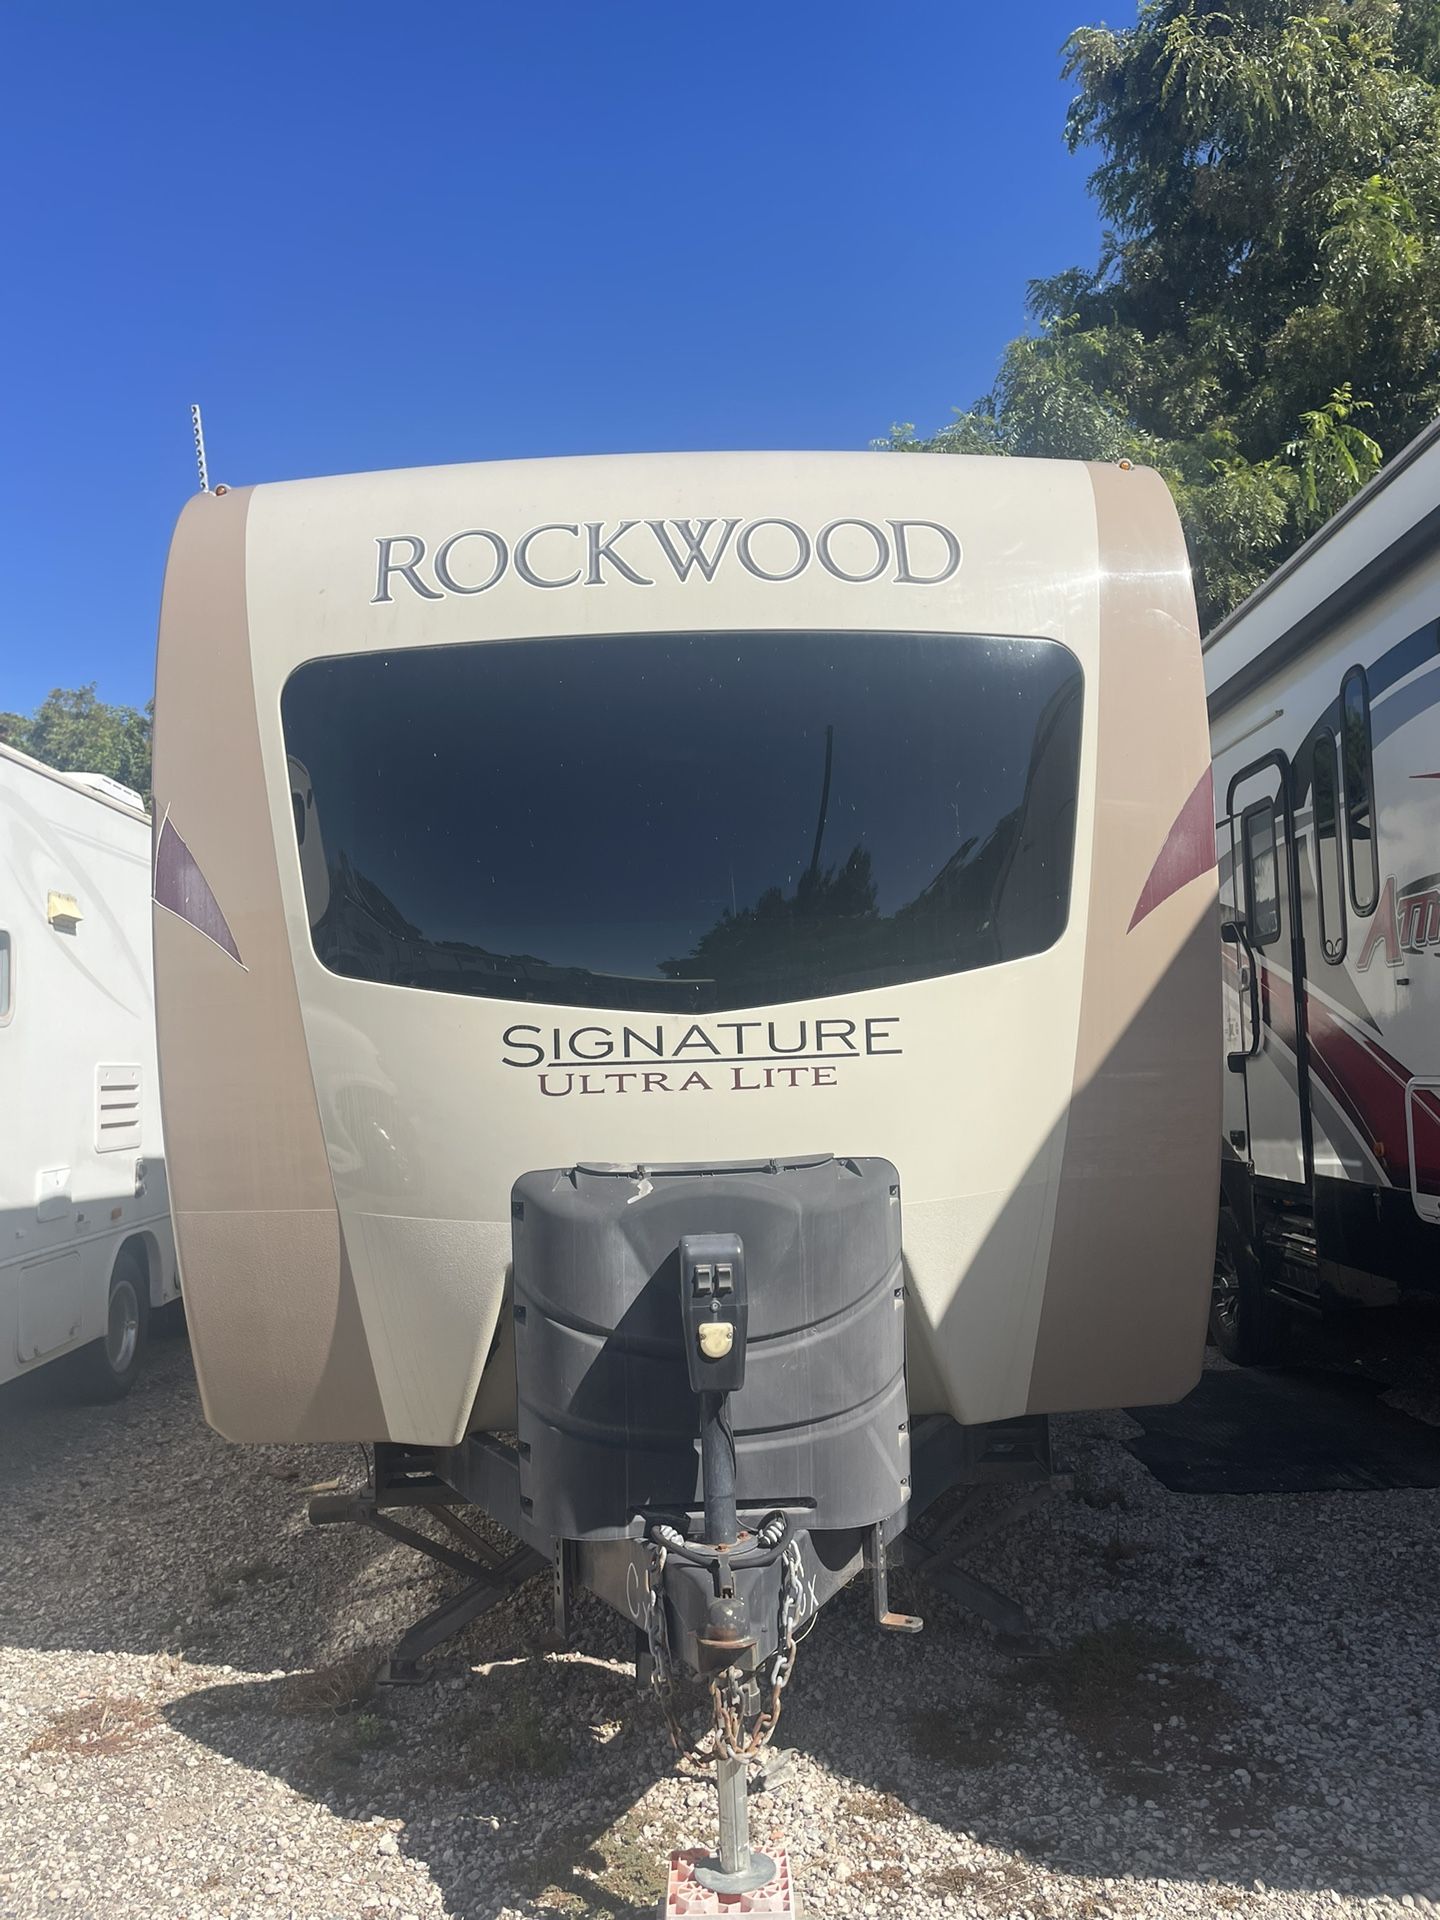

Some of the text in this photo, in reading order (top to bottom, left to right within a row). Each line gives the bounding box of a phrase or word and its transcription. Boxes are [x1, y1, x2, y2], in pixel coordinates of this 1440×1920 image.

[369, 517, 962, 605] ROCKWOOD
[502, 1017, 903, 1067] SIGNATURE
[538, 1066, 838, 1097] ULTRA LITE
